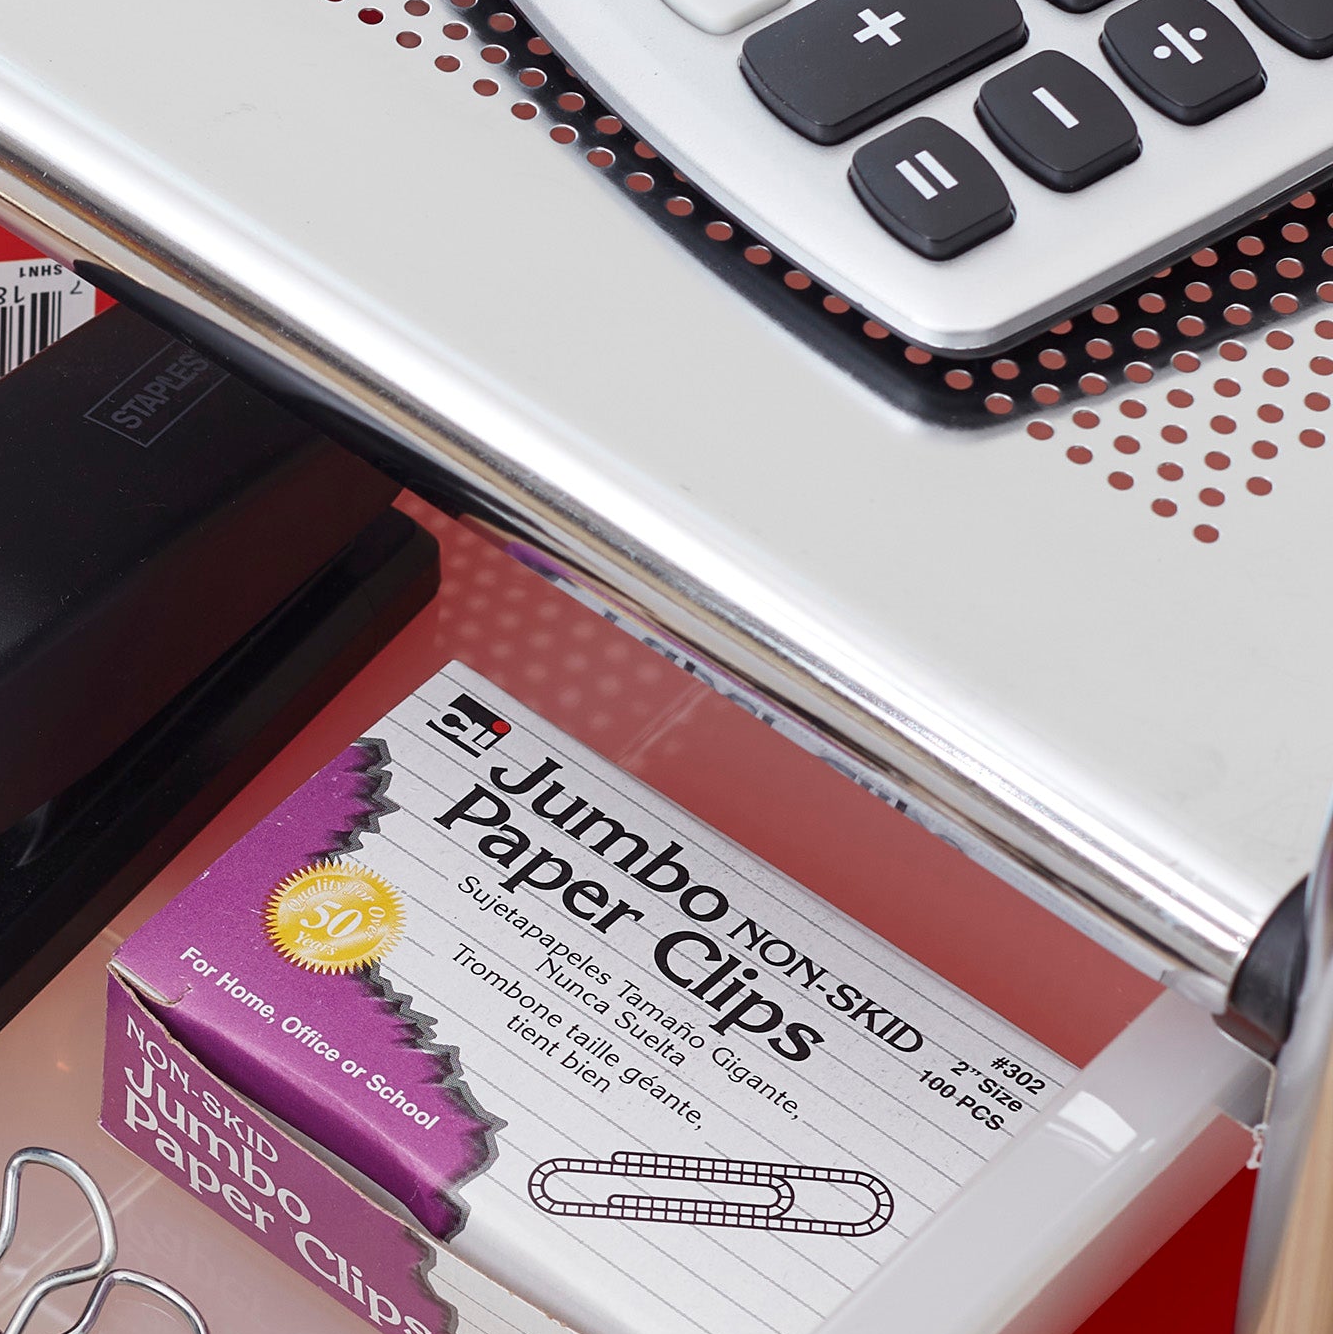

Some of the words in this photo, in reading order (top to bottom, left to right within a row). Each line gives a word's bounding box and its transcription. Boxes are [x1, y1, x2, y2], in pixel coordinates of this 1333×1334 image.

[287, 878, 345, 912] Quality
[346, 882, 375, 903] for
[293, 930, 338, 955] Years
[300, 900, 363, 938] 50
[433, 783, 644, 934] Paper
[654, 931, 824, 1062] Clips
[490, 757, 729, 922] Jumbo
[726, 917, 924, 1053] NON-SKID
[179, 945, 218, 978] For
[216, 970, 277, 1025] Home,
[281, 1014, 341, 1062] Office
[341, 1058, 368, 1078] or
[366, 1074, 440, 1130] School
[452, 943, 563, 1028] Trombone
[567, 1023, 621, 1068] taille
[619, 1067, 704, 1131] géante,
[457, 875, 612, 985] Sujetapapeles
[618, 980, 705, 1049] Tamaño
[711, 1045, 800, 1121] Gigante,
[507, 1013, 560, 1057] tient
[560, 1049, 612, 1093] bien
[535, 957, 610, 1015] Nunca
[615, 1010, 686, 1067] Suelta
[125, 1015, 280, 1164] NON-SKID
[919, 1069, 957, 1100] 100
[955, 1094, 1005, 1131] PCS
[978, 1077, 1024, 1112] Size
[990, 1056, 1046, 1095] #302
[124, 1058, 312, 1226] Jumbo
[124, 1085, 275, 1234] Paper
